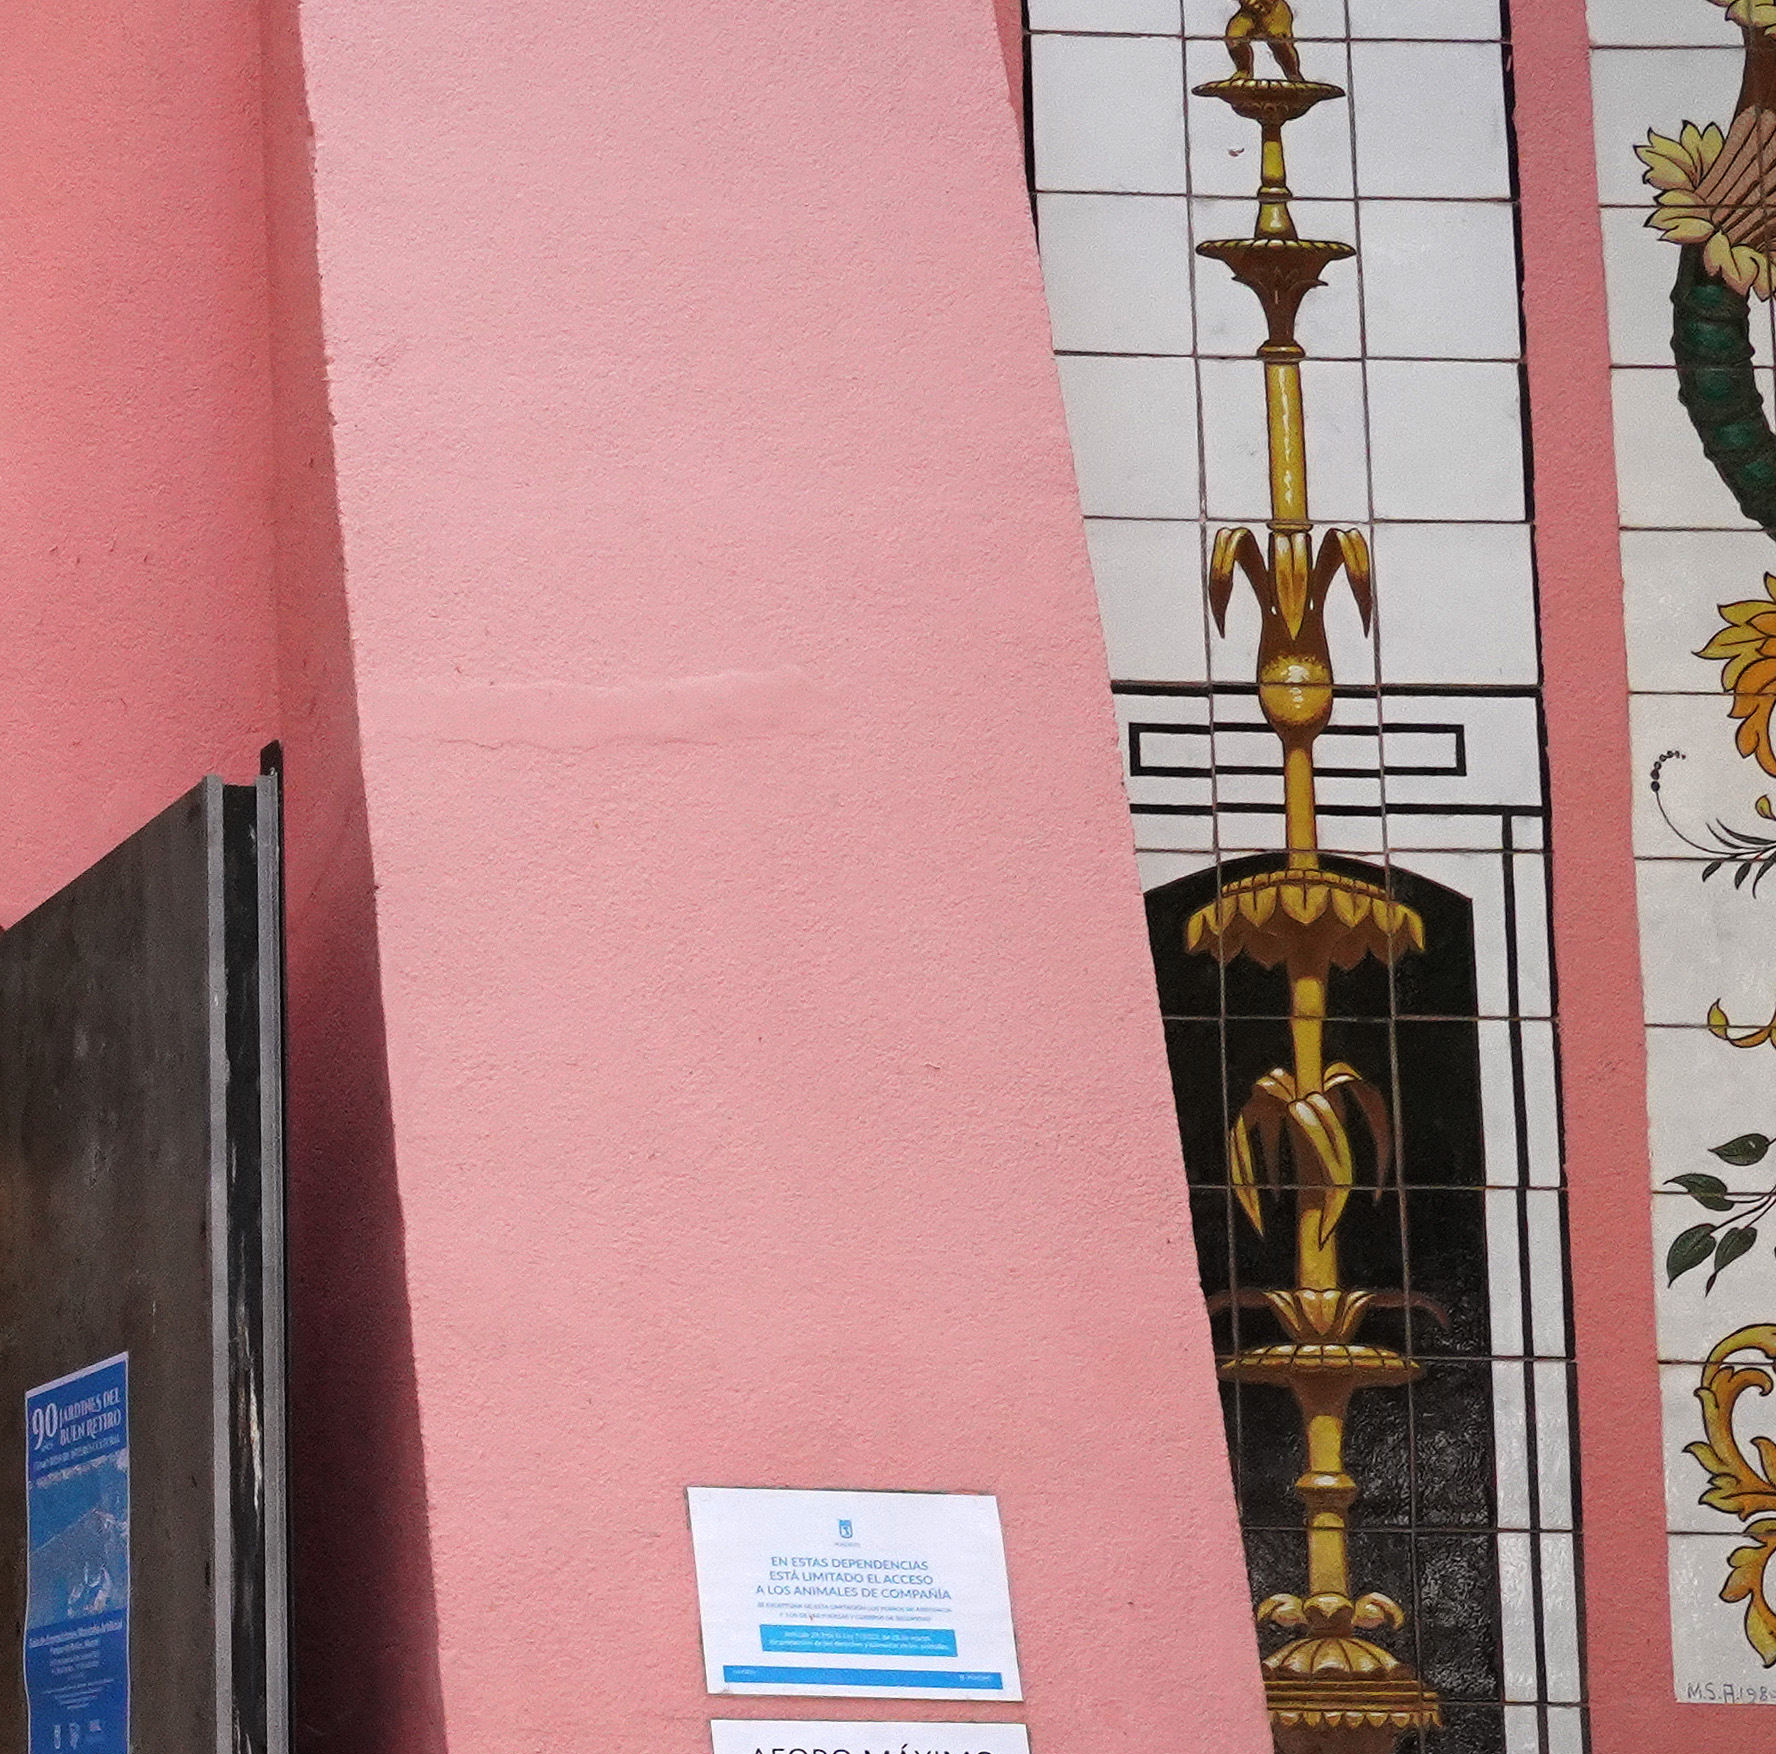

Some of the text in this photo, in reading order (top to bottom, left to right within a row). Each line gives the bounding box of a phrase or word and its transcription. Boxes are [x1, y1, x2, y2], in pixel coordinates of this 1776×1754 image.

[32, 1402, 58, 1450] 90
[771, 1557, 928, 1571] EN ESTAS DEPENDENCIAS
[802, 1571, 864, 1584] LIMITADO
[885, 1574, 933, 1585] ACCESO
[756, 1585, 765, 1594] A
[767, 1585, 791, 1596] LOS
[794, 1586, 858, 1598] ANIMALES
[862, 1588, 878, 1598] DE
